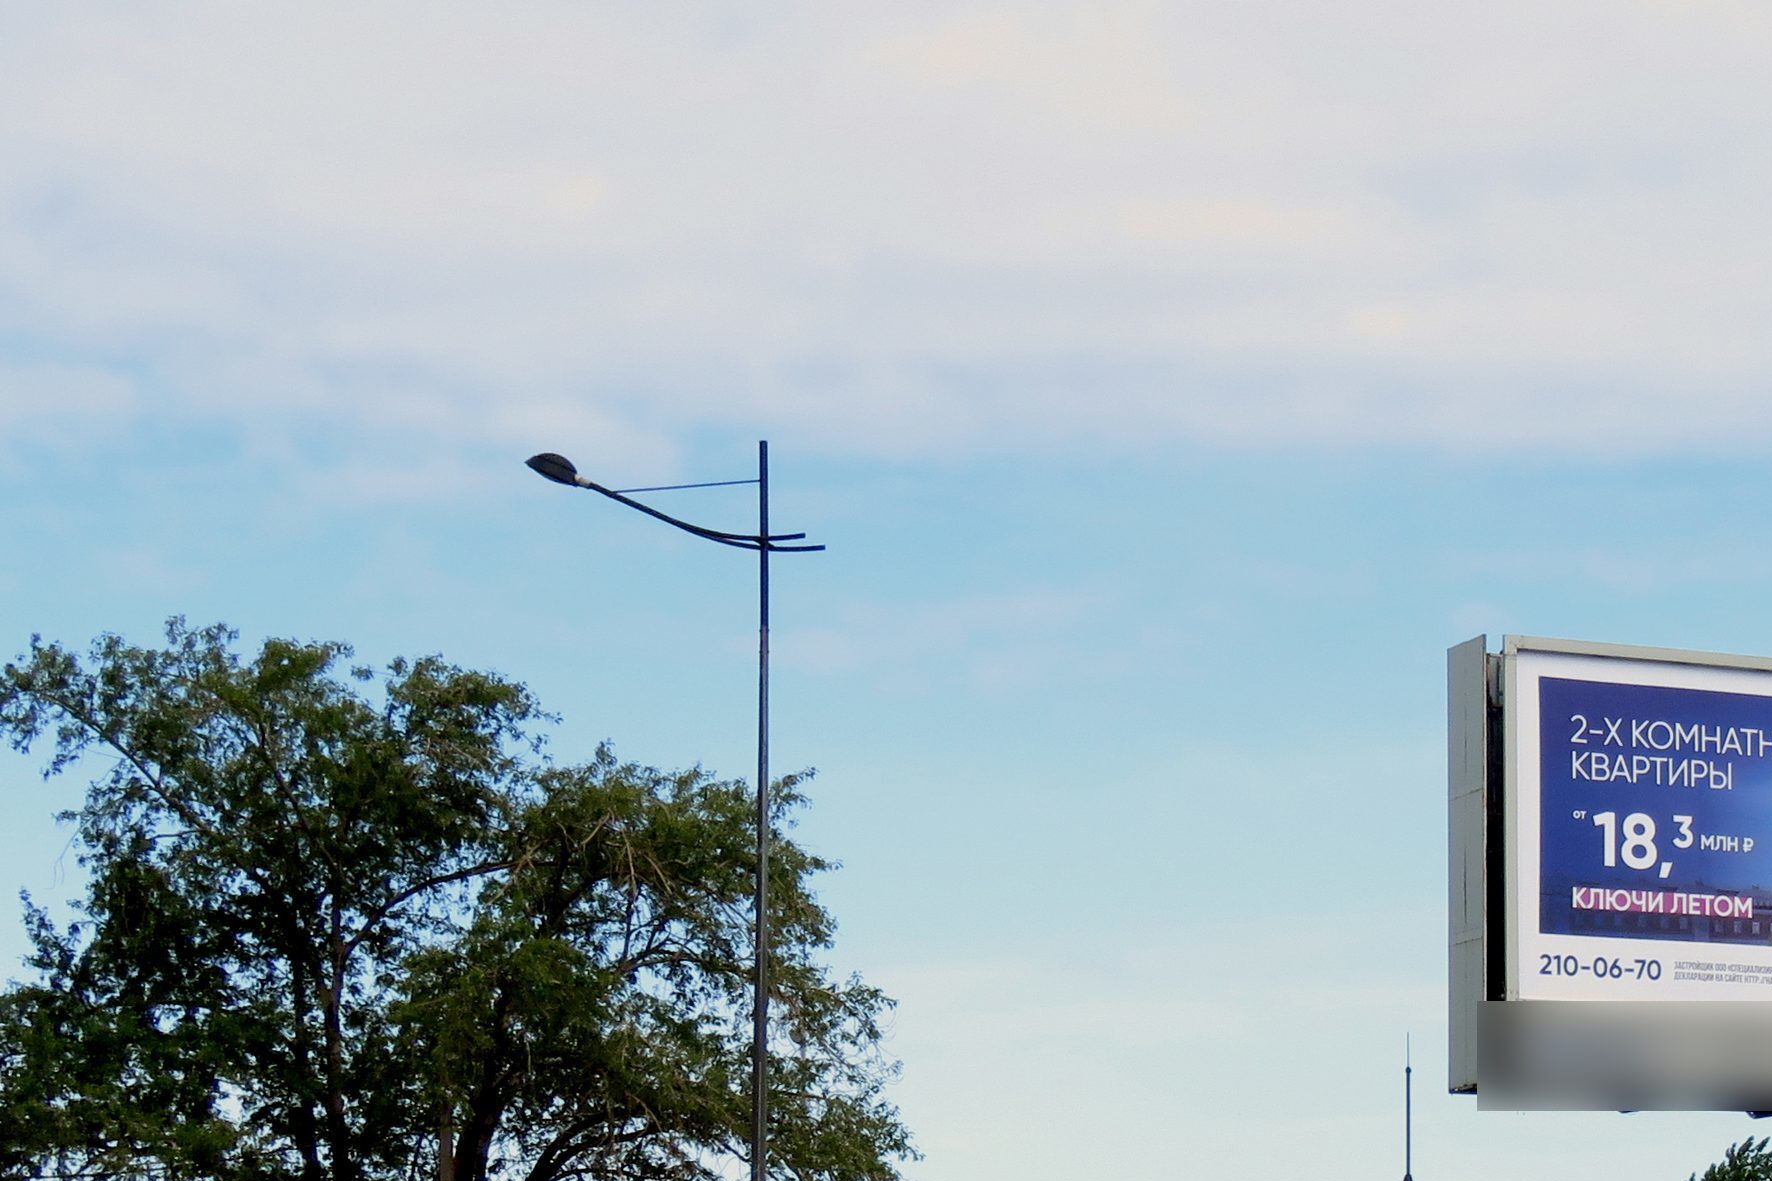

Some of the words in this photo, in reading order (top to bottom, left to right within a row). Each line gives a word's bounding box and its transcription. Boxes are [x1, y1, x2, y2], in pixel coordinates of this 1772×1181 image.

[1570, 714, 1623, 747] 2-Х
[1571, 751, 1733, 790] КВАРТИРЫ
[1700, 834, 1739, 852] МЛН
[1572, 886, 1664, 914] КЛЮЧИ
[1670, 892, 1753, 919] ЛЕТОМ
[1539, 953, 1662, 981] 210-06-70
